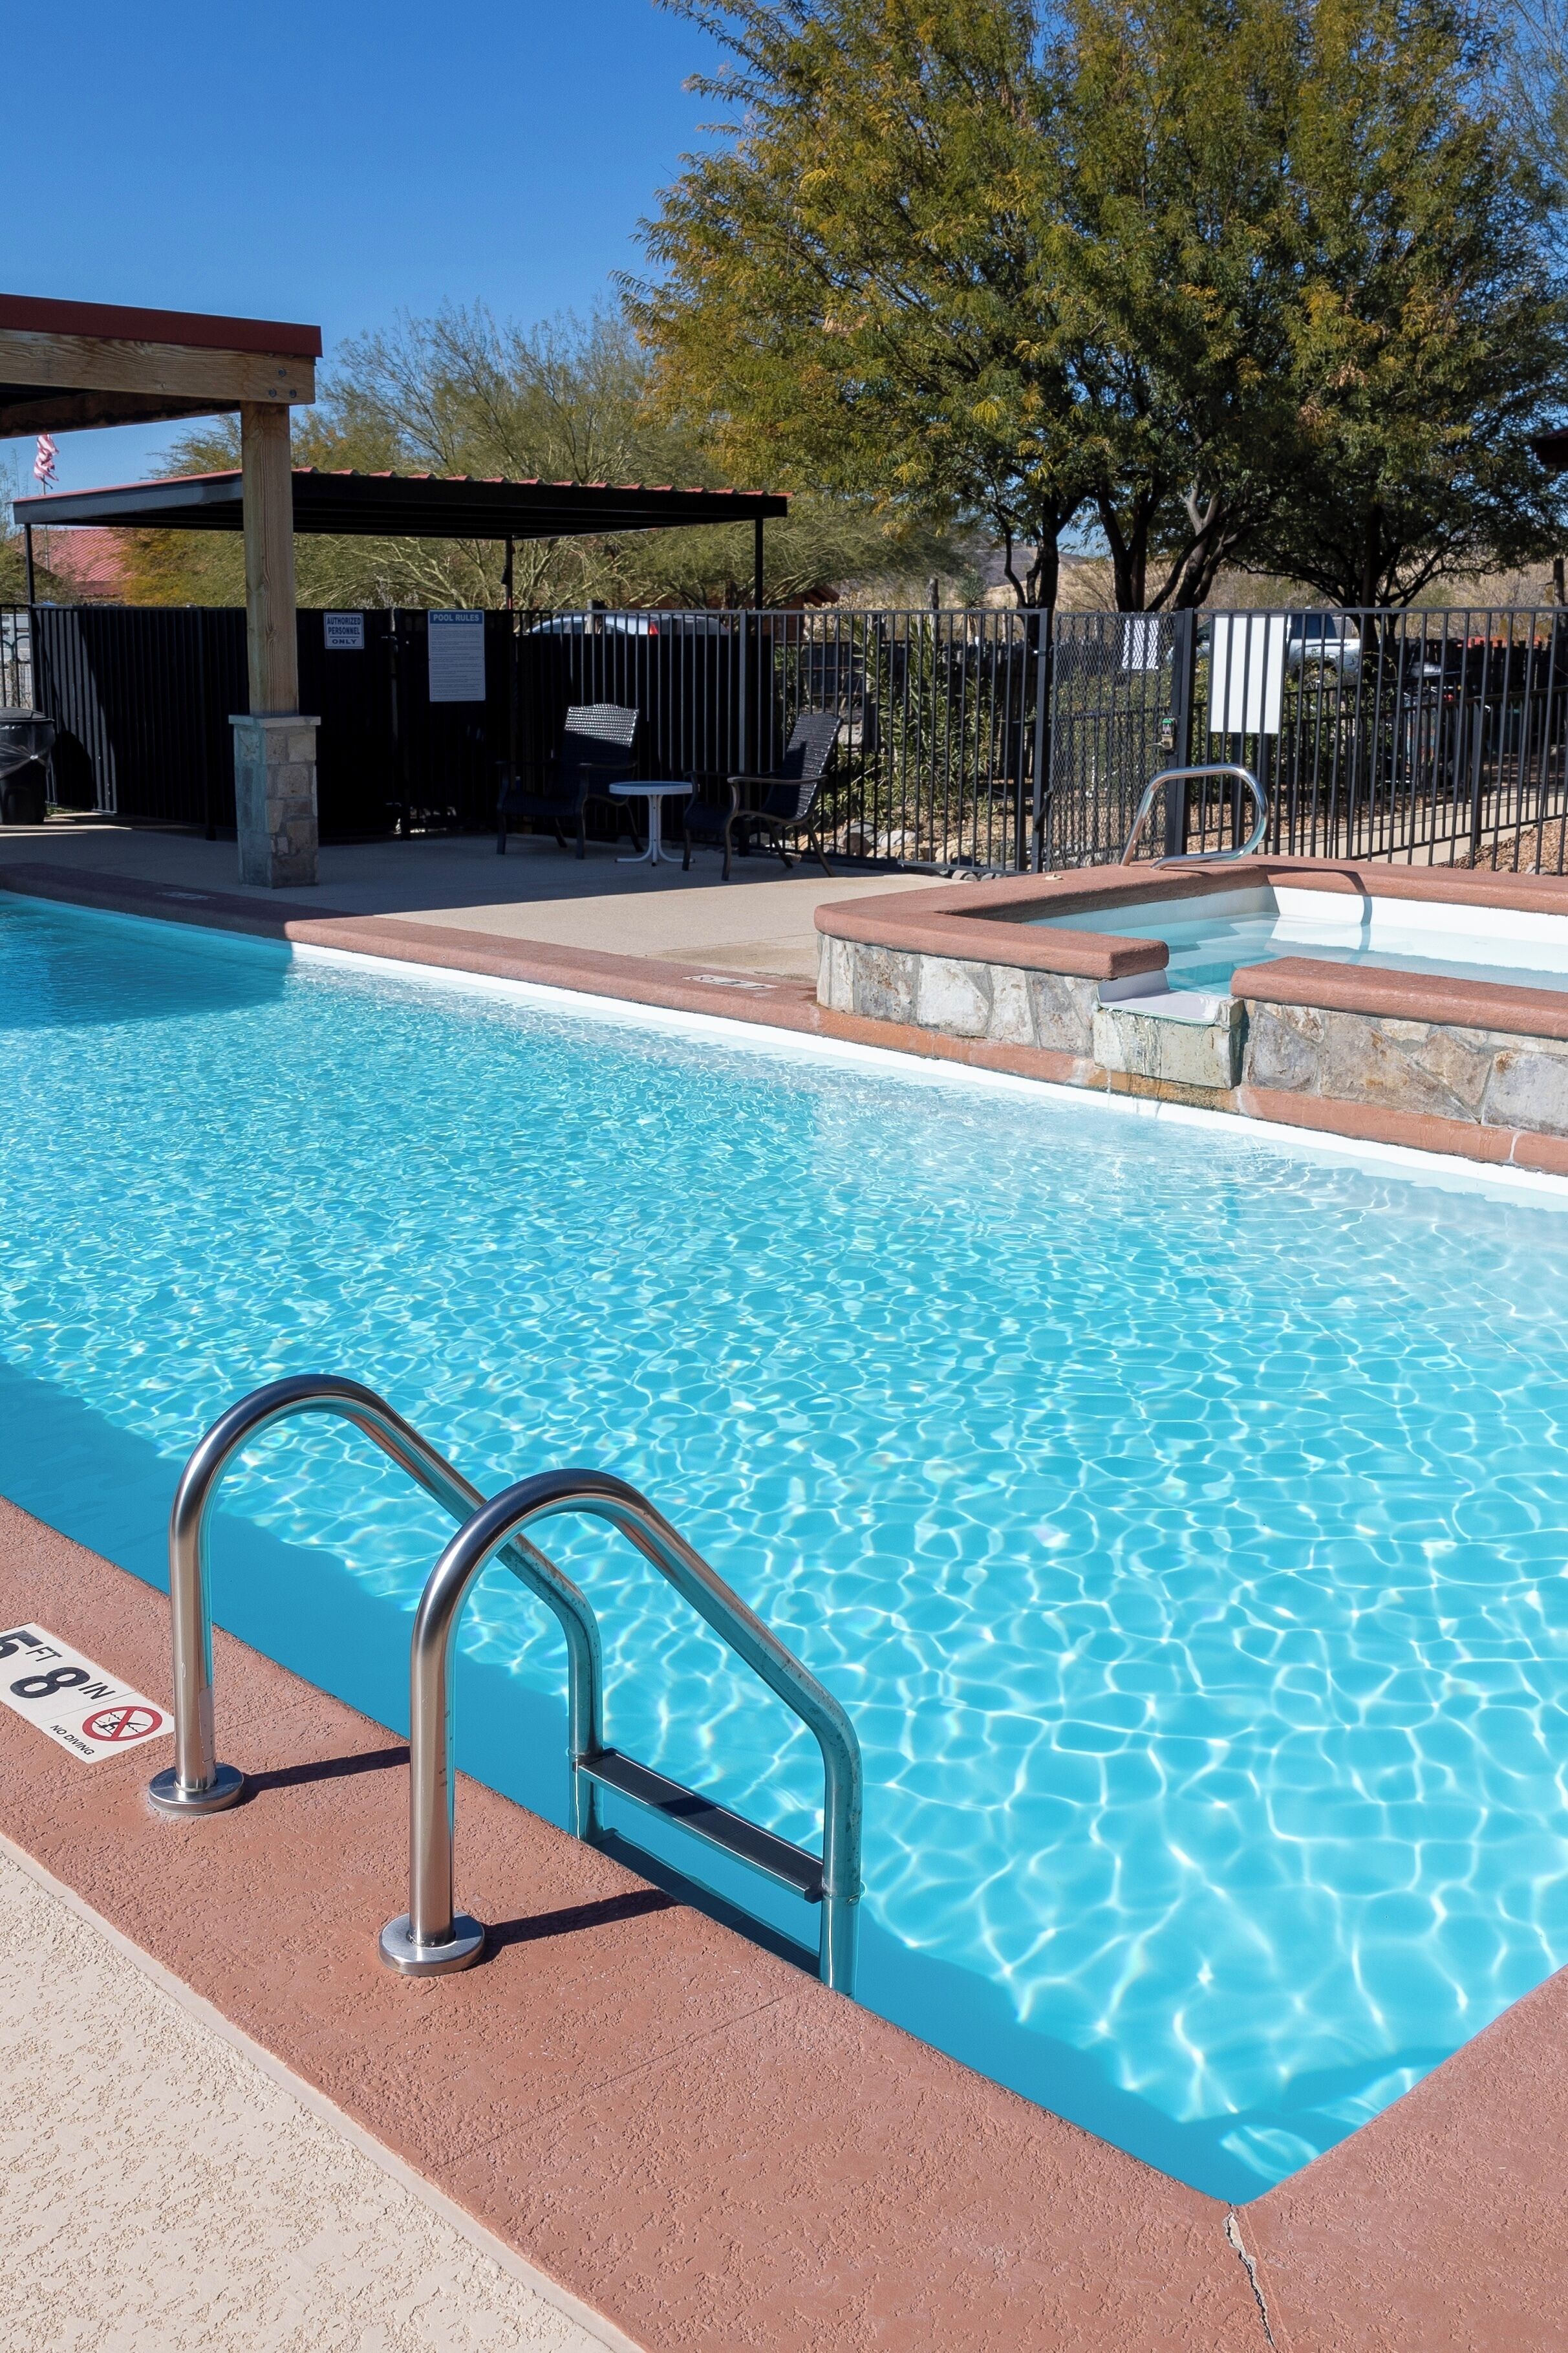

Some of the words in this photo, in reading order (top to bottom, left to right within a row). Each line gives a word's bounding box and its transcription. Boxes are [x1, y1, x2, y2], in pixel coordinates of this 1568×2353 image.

[327, 616, 361, 625] AUTHORIZED
[328, 626, 360, 634] PERSONNEL
[0, 1630, 44, 1659] 5
[25, 1646, 63, 1662] FT
[10, 1667, 91, 1698] 8
[78, 1682, 116, 1700] IN
[49, 1724, 67, 1735] NO
[63, 1734, 95, 1755] DIVING
